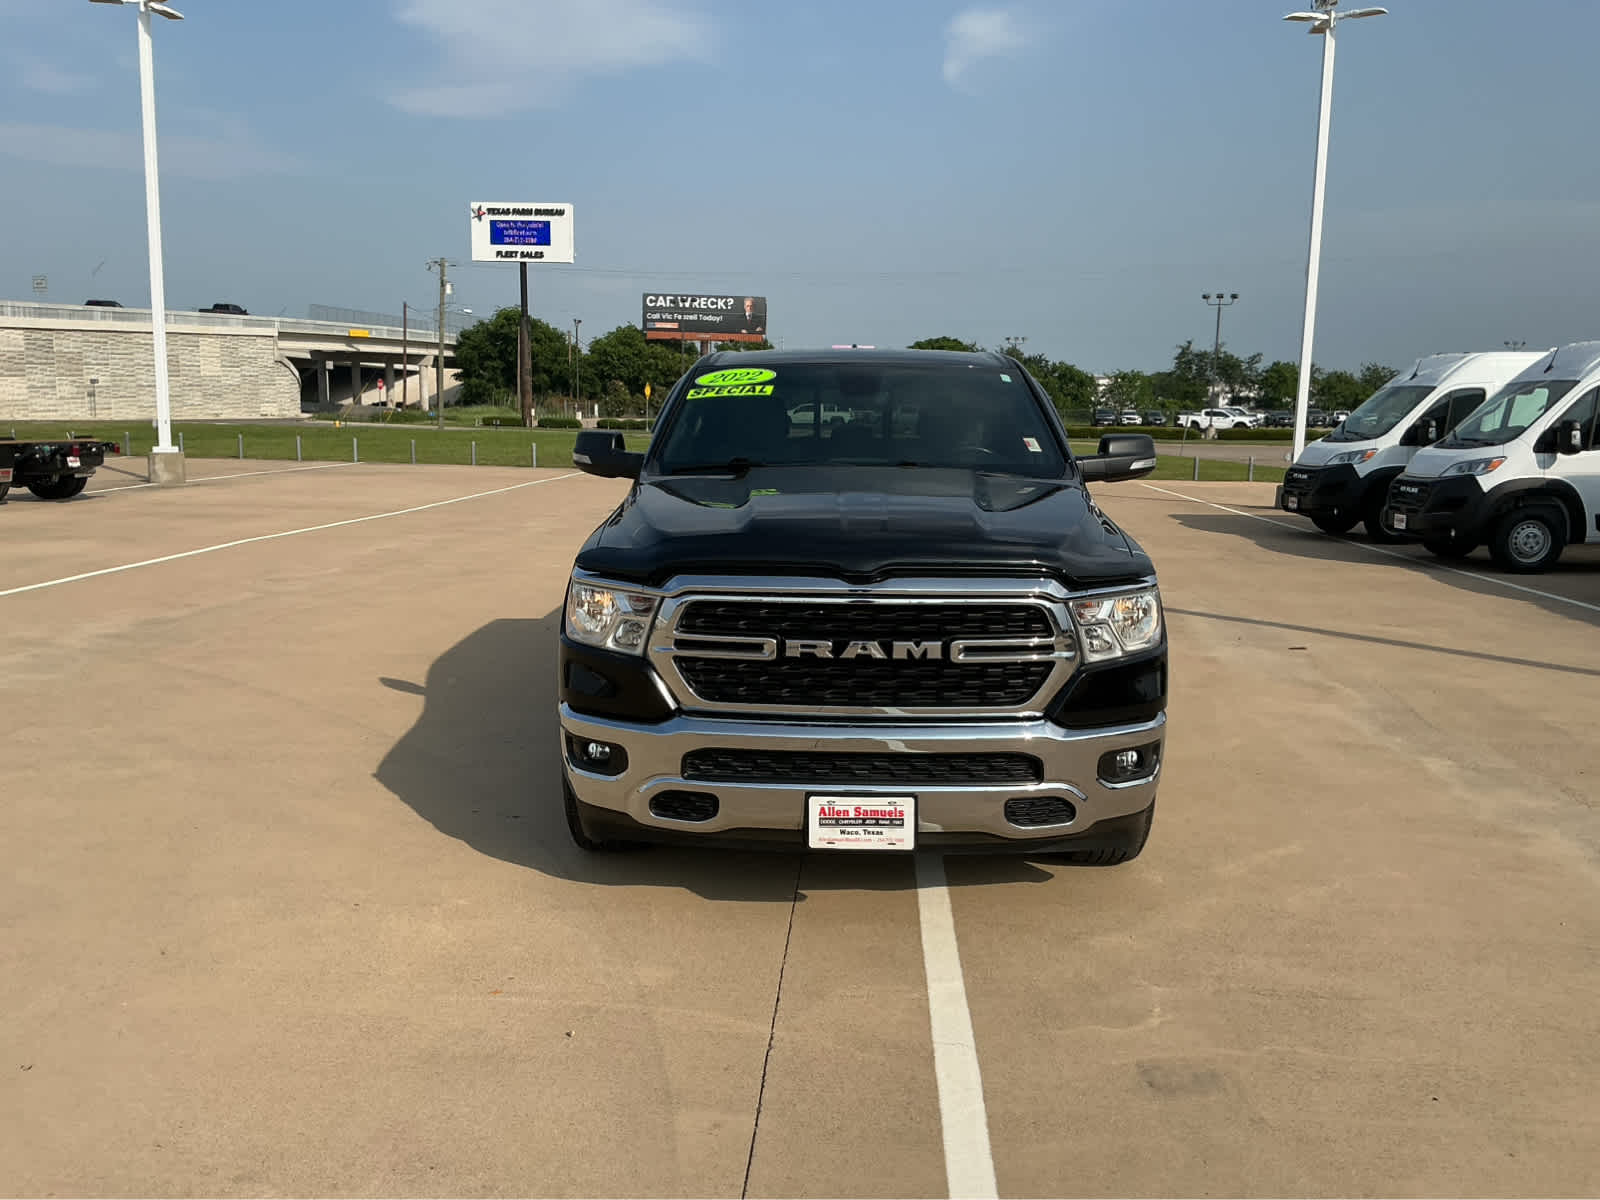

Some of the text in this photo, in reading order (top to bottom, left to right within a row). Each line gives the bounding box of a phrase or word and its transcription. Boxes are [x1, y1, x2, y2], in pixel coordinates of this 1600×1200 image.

[486, 207, 565, 217] TEXAS FARM BUREAU
[496, 250, 544, 259] FLEET SALES
[678, 296, 734, 310] WRECK?
[646, 312, 660, 320] Call
[699, 314, 723, 324] Today!
[709, 370, 764, 384] 2022
[690, 385, 769, 397] SPECIAL
[785, 639, 943, 660] RAM
[818, 806, 905, 818] Allen Samuels
